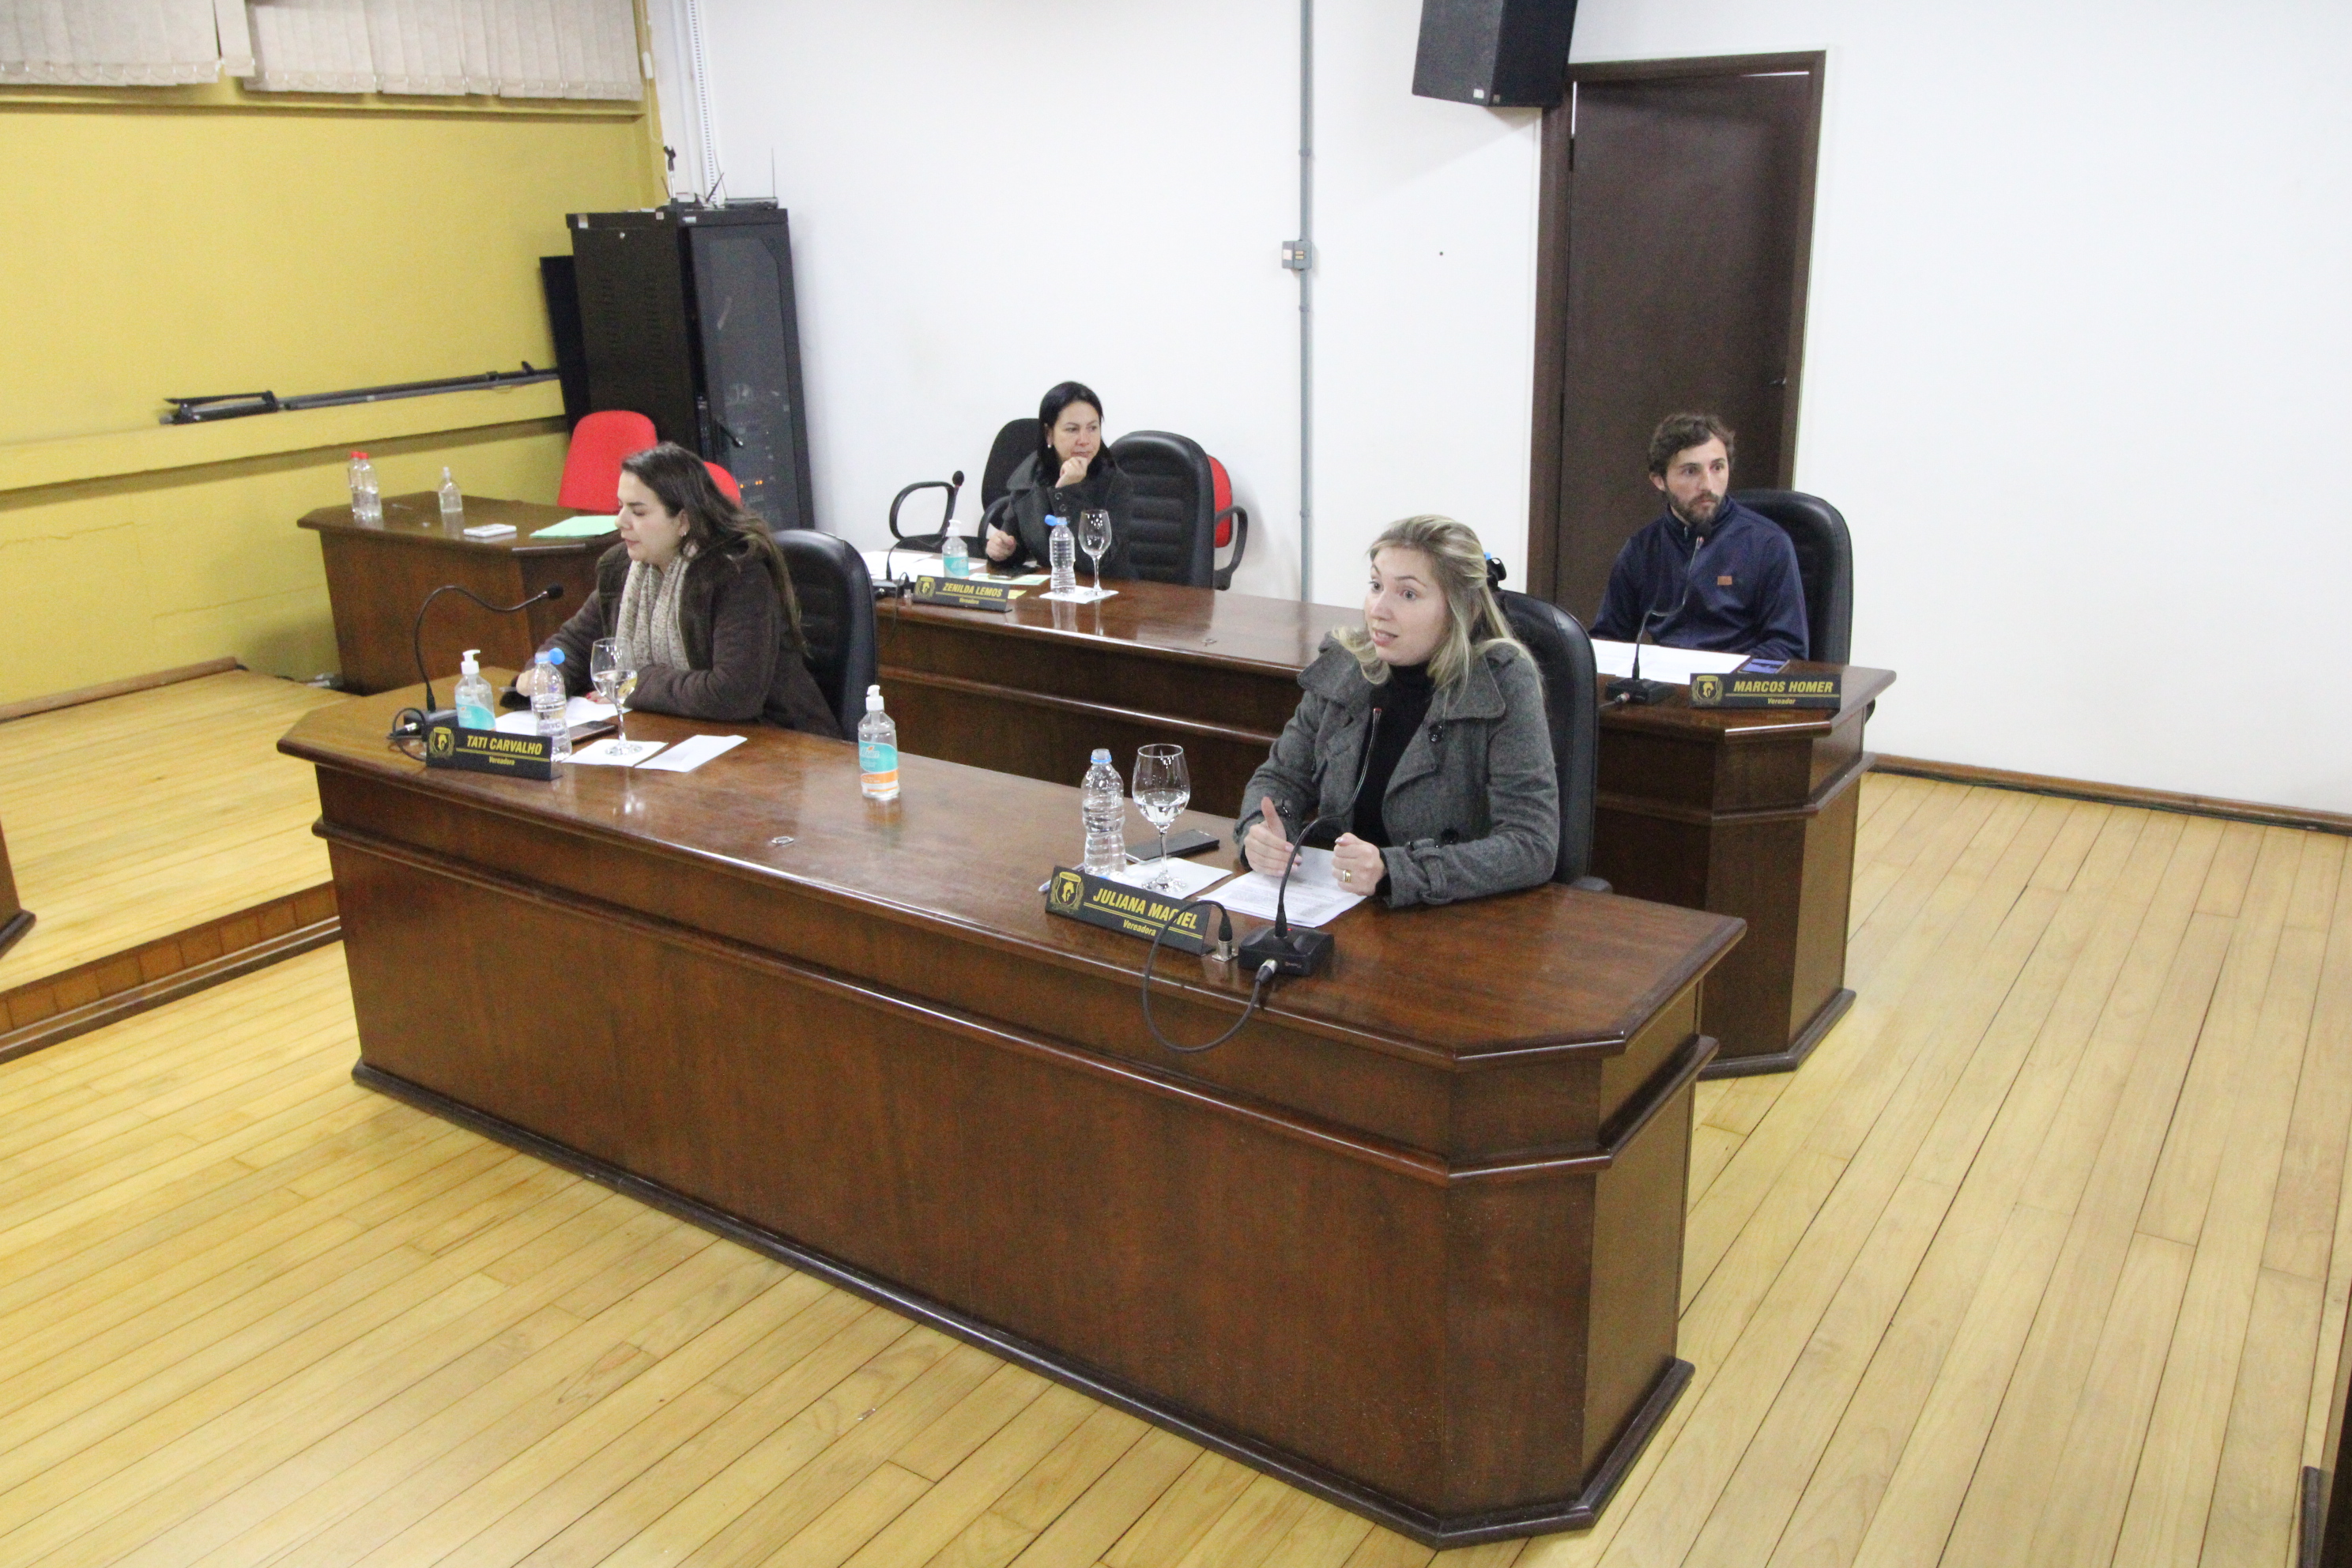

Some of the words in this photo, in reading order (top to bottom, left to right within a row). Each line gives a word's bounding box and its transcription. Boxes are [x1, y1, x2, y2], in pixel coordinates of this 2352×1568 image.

[943, 583, 974, 594] ZENILDA
[975, 586, 1003, 597] LEMOS
[1733, 680, 1786, 693] MARCOS
[1788, 681, 1834, 693] HOMER
[467, 735, 488, 748] TATI
[489, 738, 543, 756] CARVALHO
[489, 756, 515, 765] Vereadora
[1093, 888, 1146, 914] JULIANA
[1123, 919, 1157, 937] Vereadora
